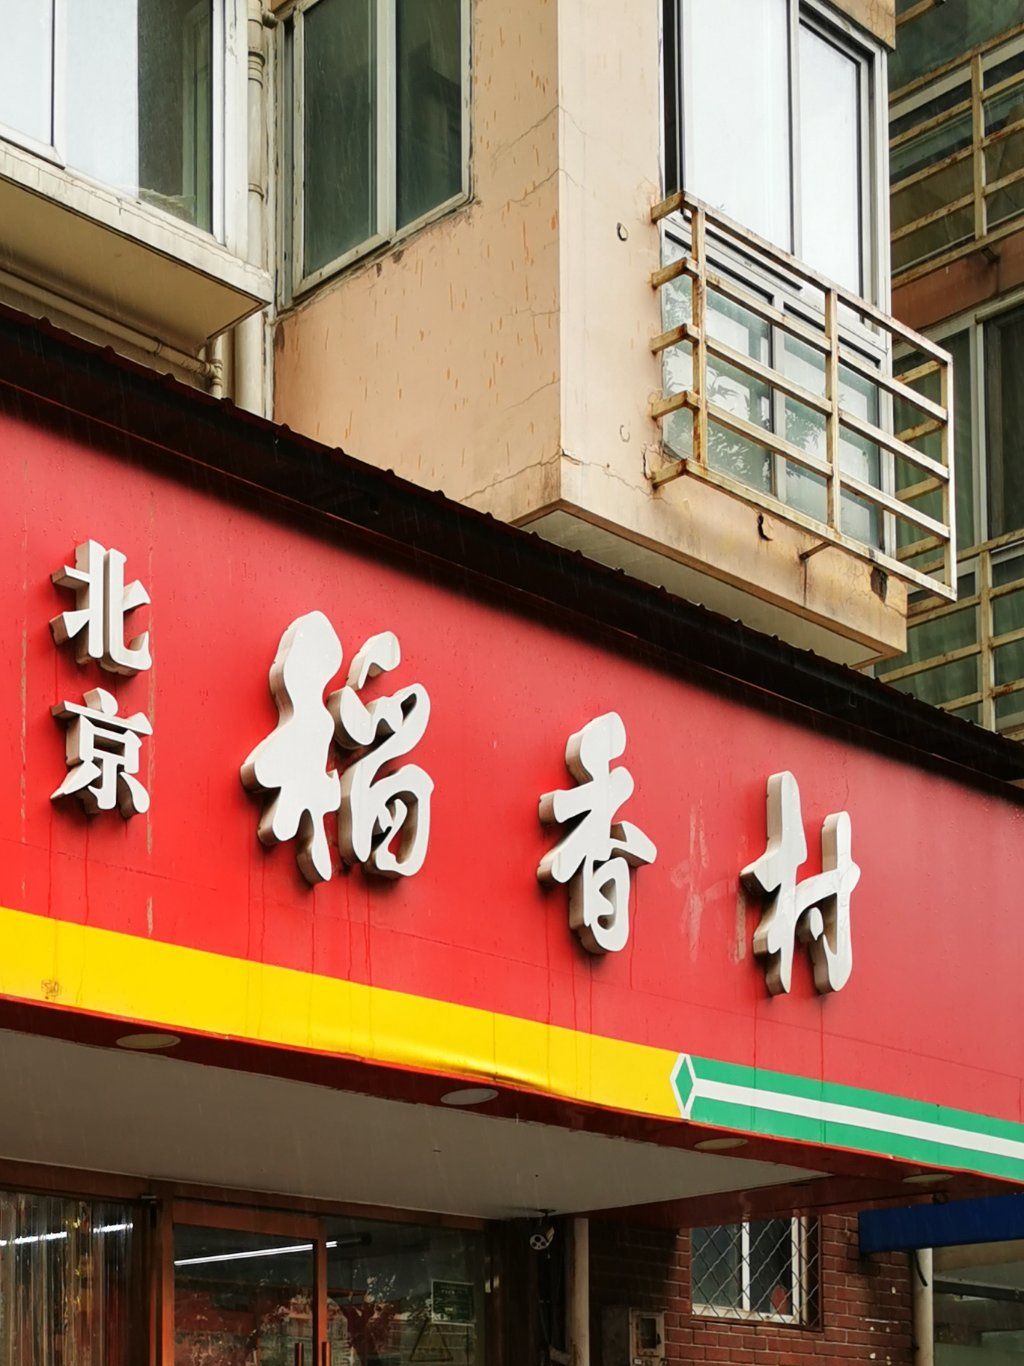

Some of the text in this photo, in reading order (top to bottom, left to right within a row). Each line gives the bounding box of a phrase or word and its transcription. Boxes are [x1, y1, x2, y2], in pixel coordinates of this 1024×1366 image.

[50, 538, 153, 817] 北京
[239, 609, 862, 998] 稻香村
